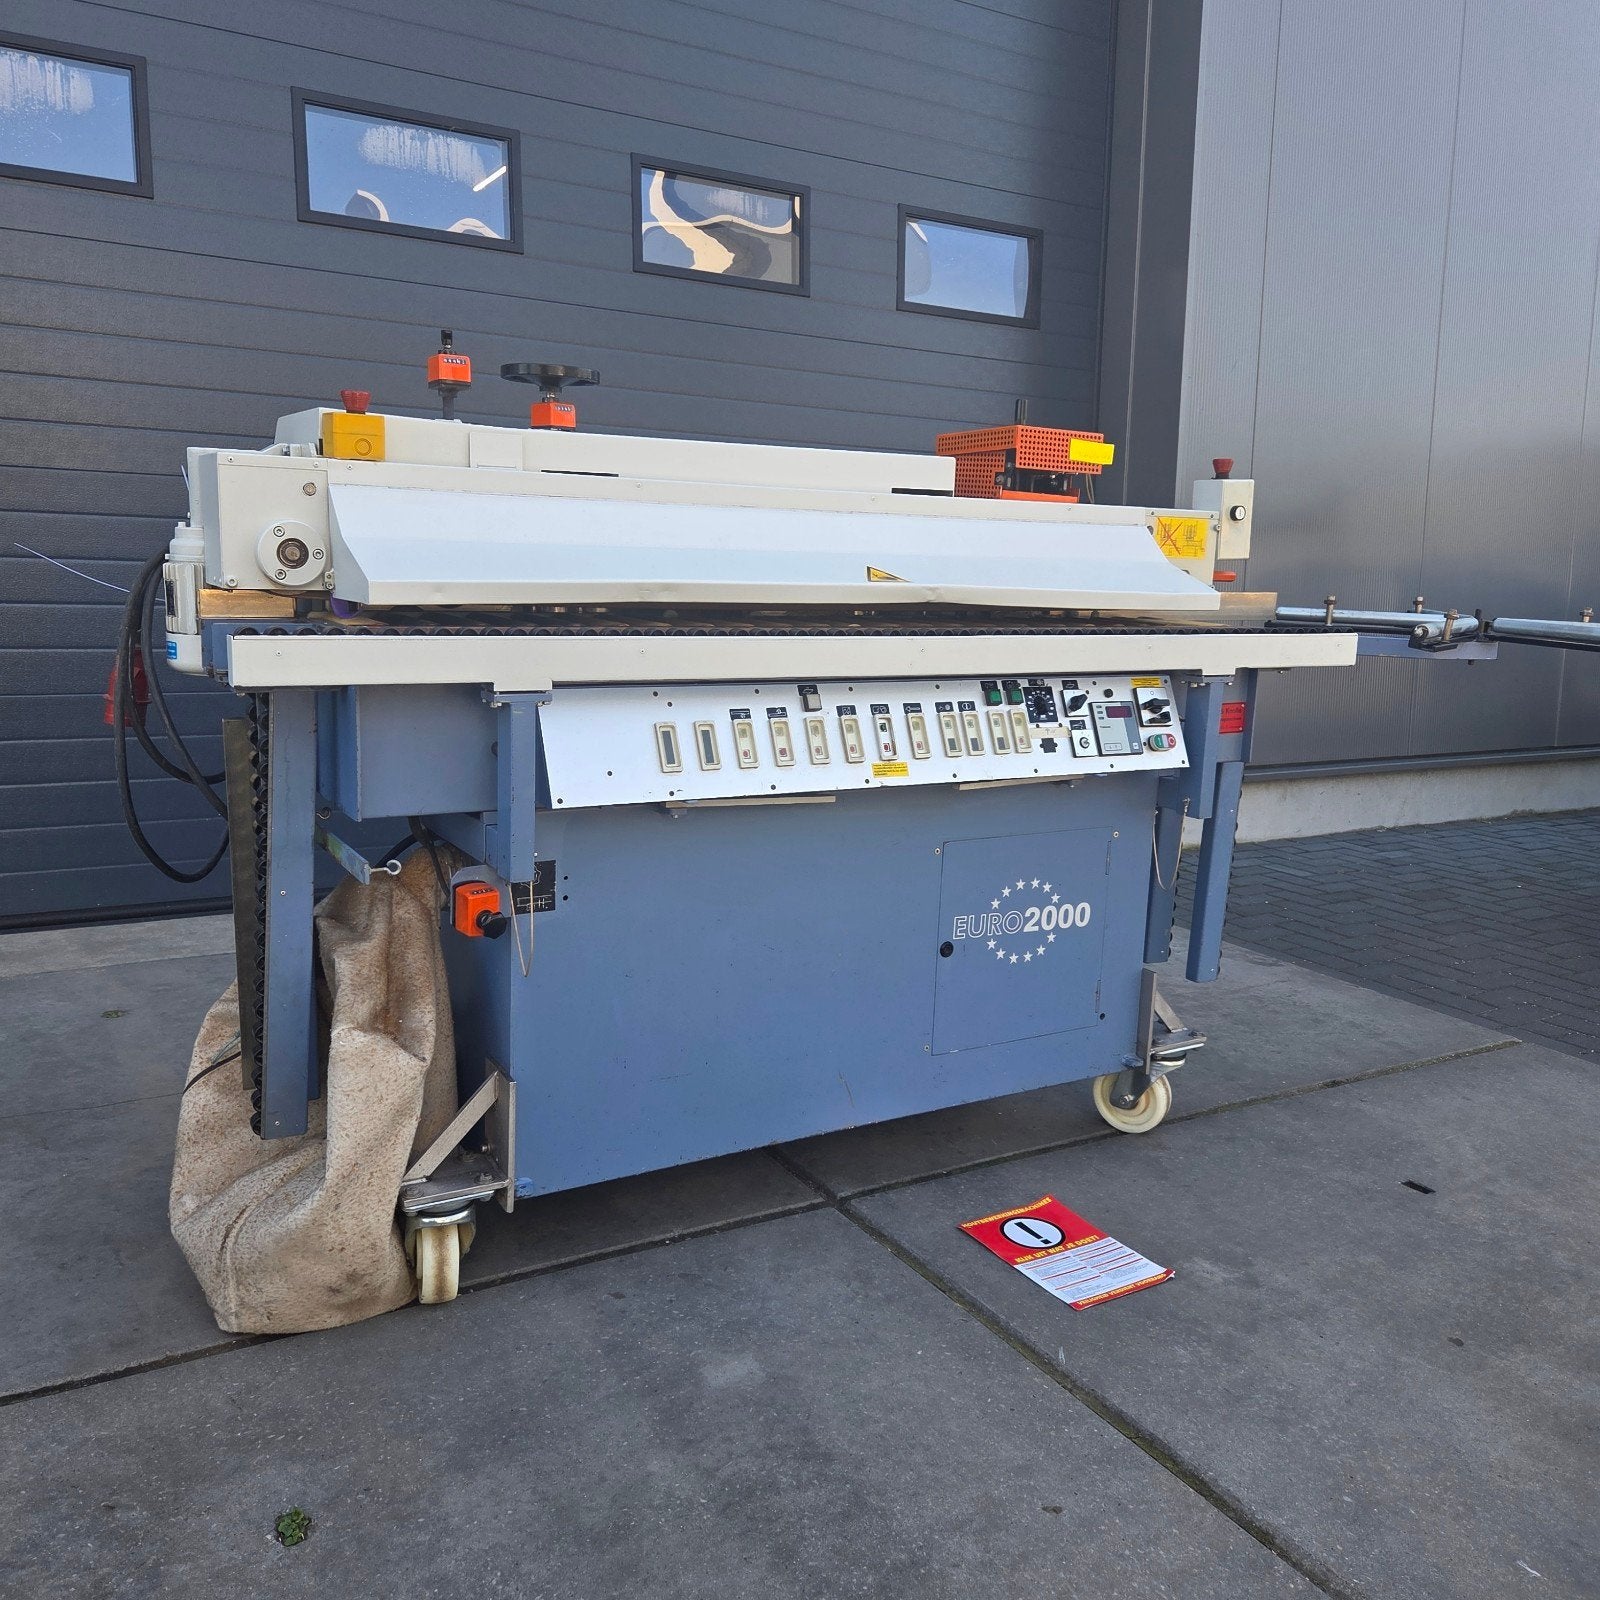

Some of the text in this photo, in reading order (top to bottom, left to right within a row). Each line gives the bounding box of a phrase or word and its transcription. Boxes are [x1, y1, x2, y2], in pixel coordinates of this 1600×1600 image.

[952, 901, 1091, 940] EURO2000
[1033, 1250, 1048, 1258] UIT
[1046, 1245, 1066, 1254] WAT
